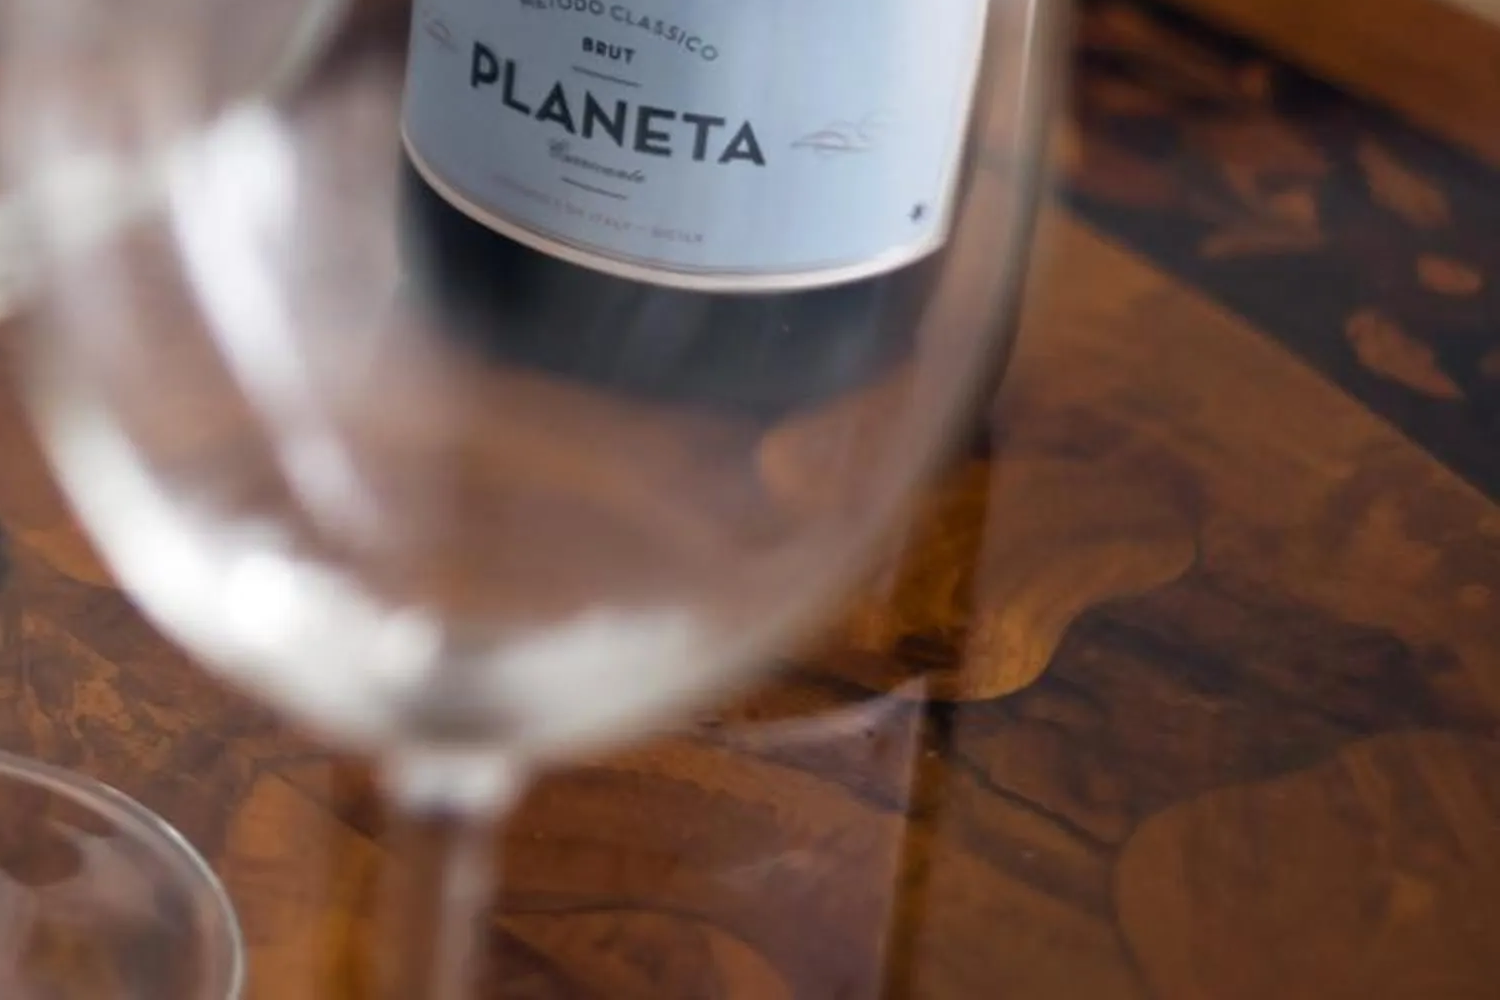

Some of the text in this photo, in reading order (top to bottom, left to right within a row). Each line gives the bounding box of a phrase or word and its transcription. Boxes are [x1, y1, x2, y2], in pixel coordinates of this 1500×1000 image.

[582, 36, 636, 65] BRUT
[609, 4, 719, 62] CLASSICO
[470, 40, 766, 167] PLANETA
